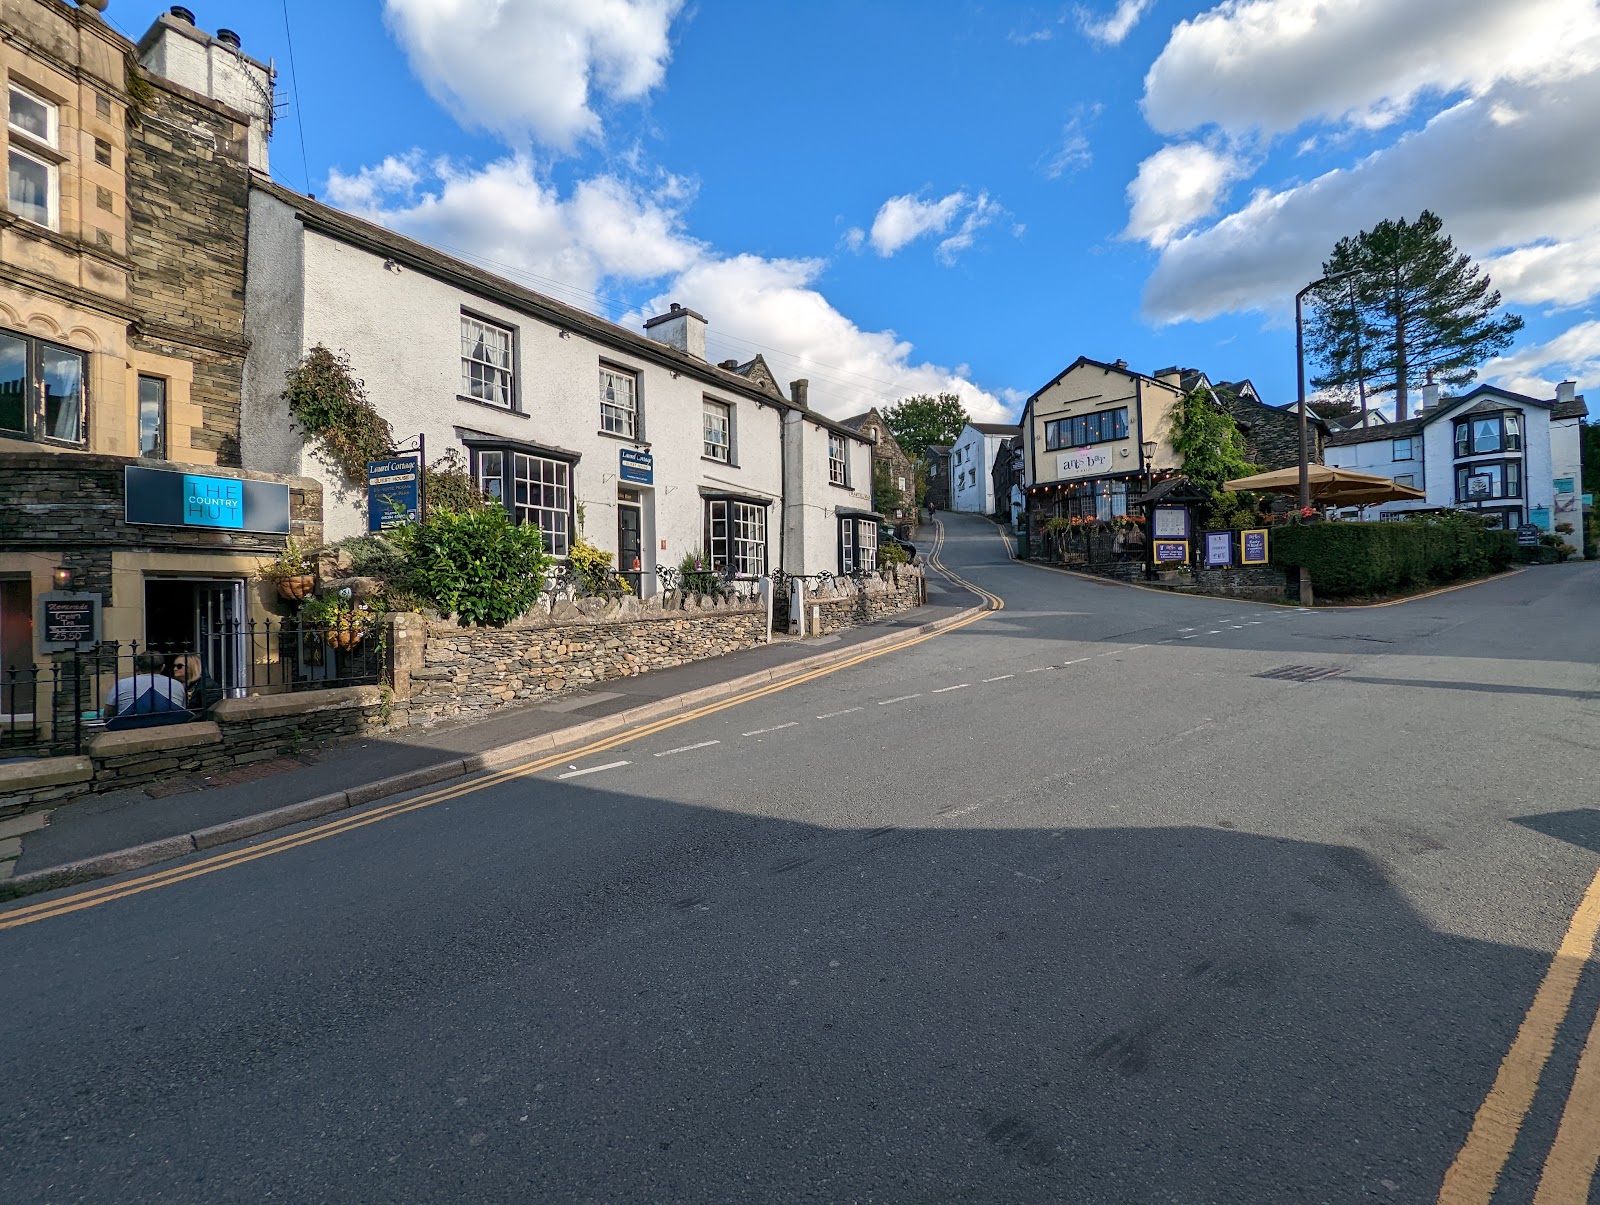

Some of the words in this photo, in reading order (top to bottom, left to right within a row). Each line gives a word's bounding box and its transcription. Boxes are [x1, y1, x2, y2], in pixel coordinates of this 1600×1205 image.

[369, 461, 391, 473] Laurel
[391, 462, 415, 472] Cottage
[1063, 457, 1085, 470] arts
[1086, 455, 1106, 467] bar
[188, 481, 237, 499] THE
[188, 496, 238, 507] COUNTRY
[189, 503, 238, 520] HUT
[55, 612, 81, 620] Cream
[51, 632, 82, 640] £5.50
